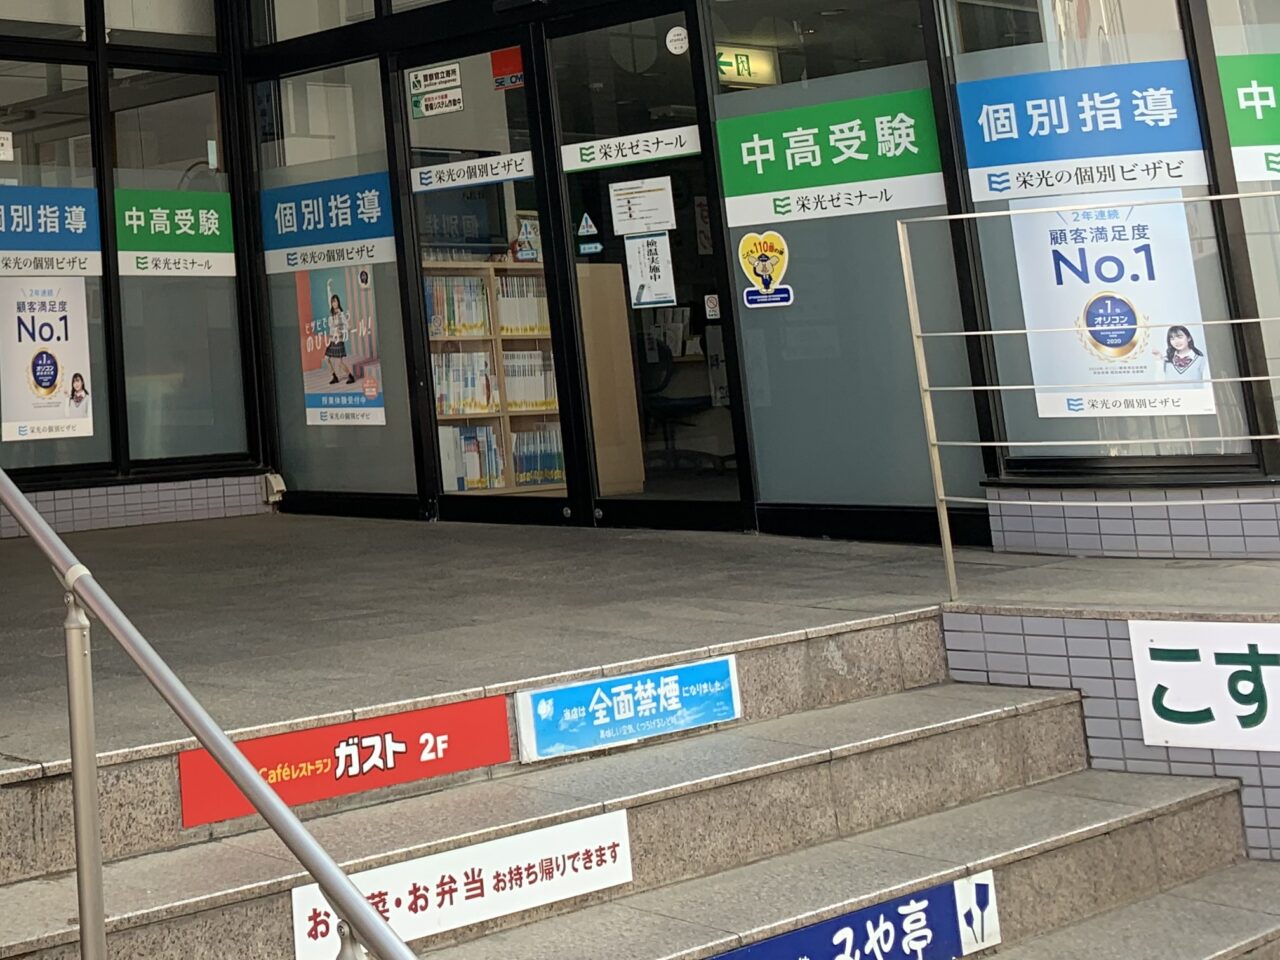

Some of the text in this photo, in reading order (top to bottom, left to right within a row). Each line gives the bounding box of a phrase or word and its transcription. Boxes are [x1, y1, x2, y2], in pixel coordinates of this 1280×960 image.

[1237, 80, 1276, 120] 中
[977, 86, 1178, 143] 個別指導
[598, 134, 687, 161] 栄光ゼミナール
[740, 112, 919, 175] 中高受験
[434, 157, 524, 185] 栄光の個別ビザビ
[1015, 160, 1184, 190] 栄光の個別ビザビ
[274, 189, 382, 235] 個別指導
[796, 188, 893, 213] 栄光ゼミナール
[124, 206, 220, 236] 中高受験
[1072, 209, 1120, 222] 2年連続
[1048, 224, 1151, 246] 顧客満足度
[1, 256, 88, 270] 栄光の個別ビザビ
[151, 256, 212, 270] 栄光ゼミナール
[300, 244, 375, 265] 栄光の個別ビザビ
[1051, 243, 1156, 286] No.1
[16, 300, 68, 313] 顧客満足度
[1094, 315, 1128, 325] オリコン
[16, 314, 69, 343] No.1
[1087, 396, 1181, 410] 栄光の個別ビザビ
[1148, 643, 1280, 729] こす
[334, 731, 407, 780] ガスト
[418, 732, 449, 762] 2F
[306, 841, 621, 940] お菜・お弁当 お持ち帰りできます
